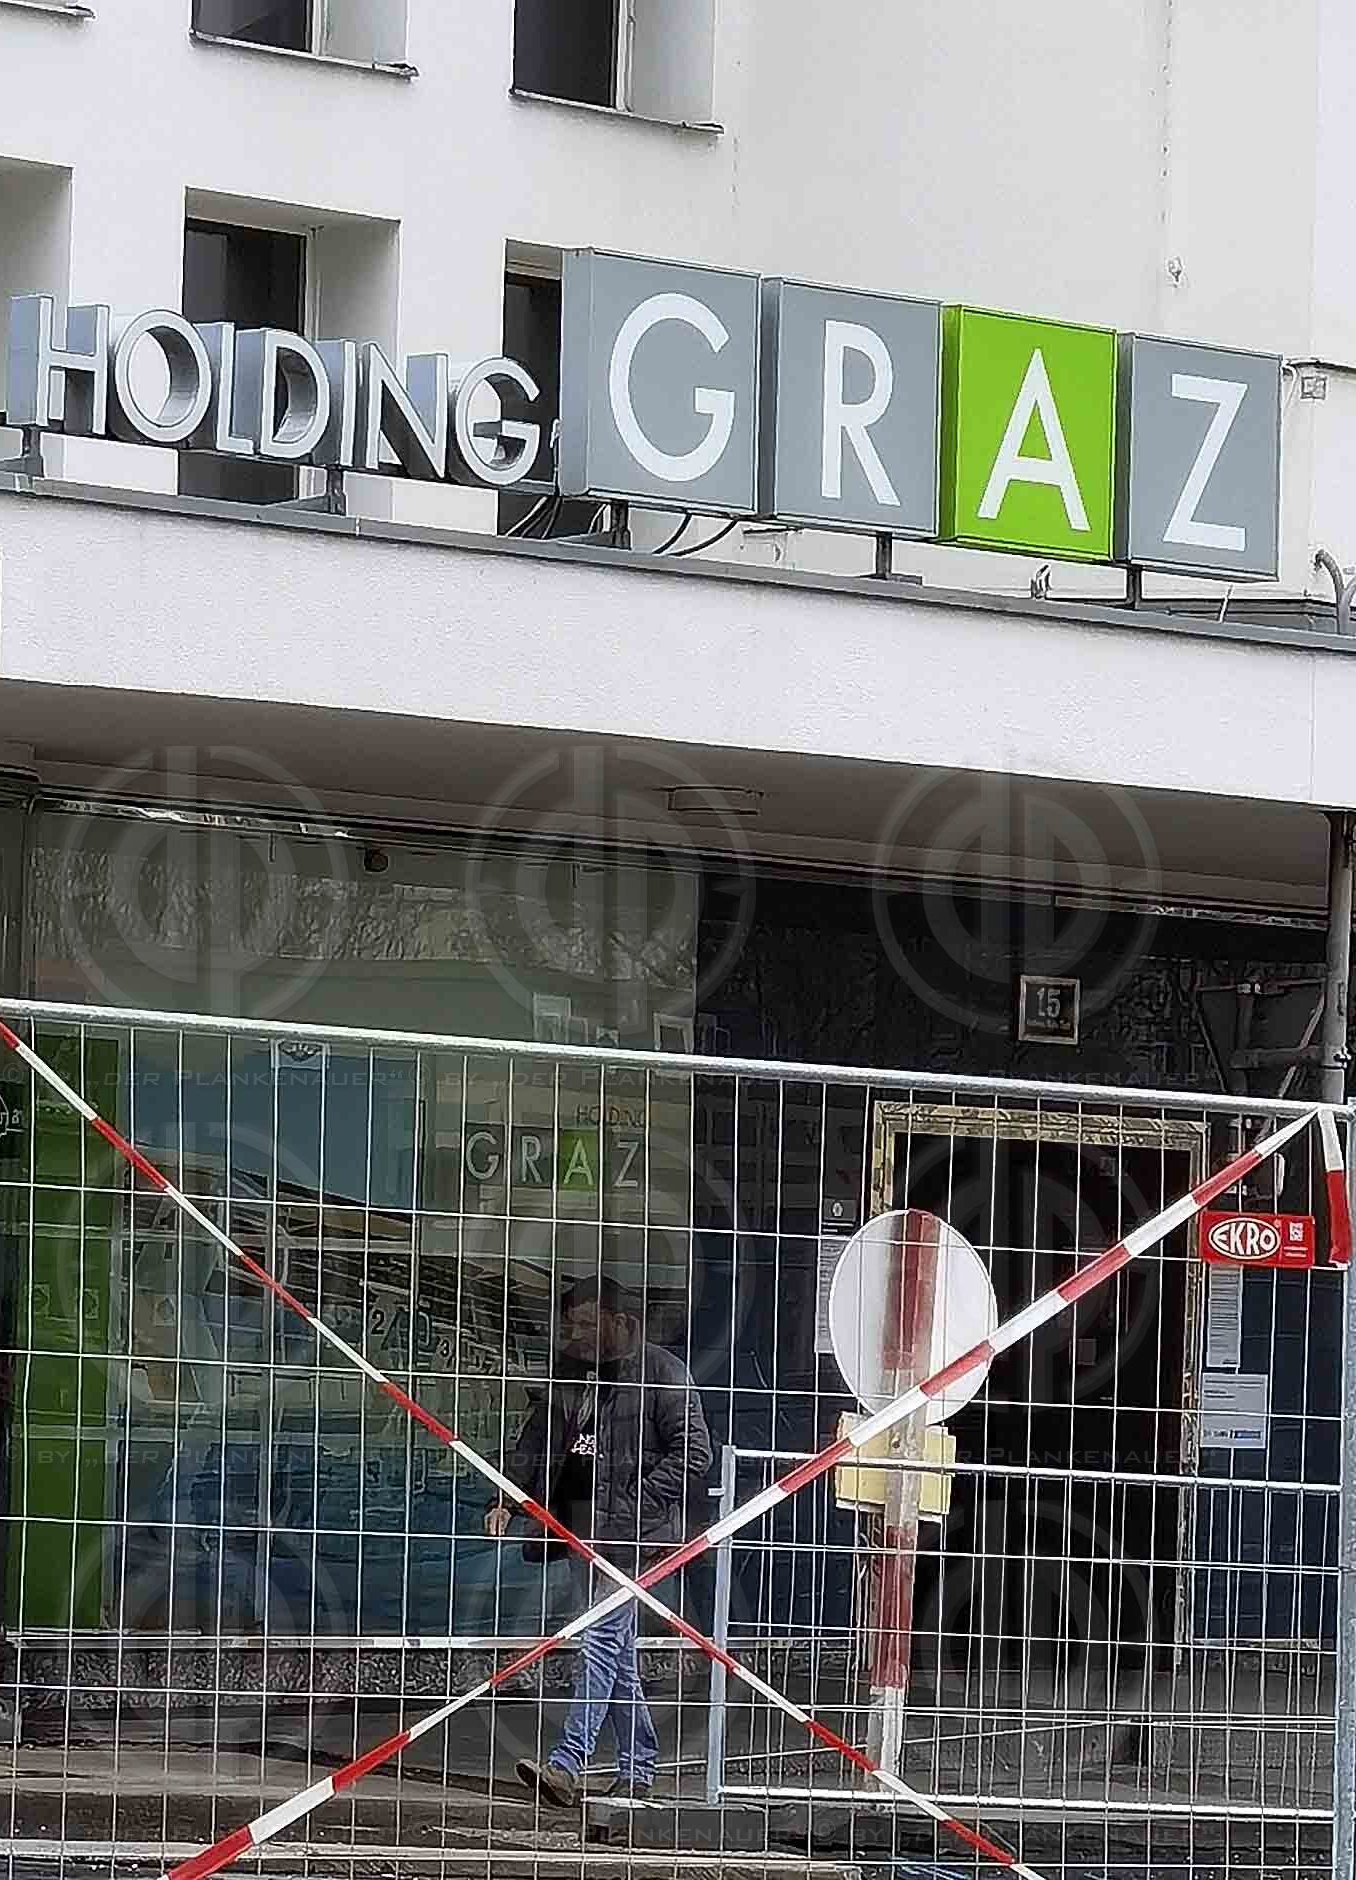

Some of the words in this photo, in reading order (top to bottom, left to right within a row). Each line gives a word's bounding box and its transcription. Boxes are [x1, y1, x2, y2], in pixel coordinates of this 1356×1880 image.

[36, 293, 542, 488] HOLDING
[609, 291, 1250, 551] GRAZ
[1036, 987, 1061, 1018] 15
[466, 1131, 639, 1188] GRAZ
[1212, 1221, 1276, 1255] EKRO
